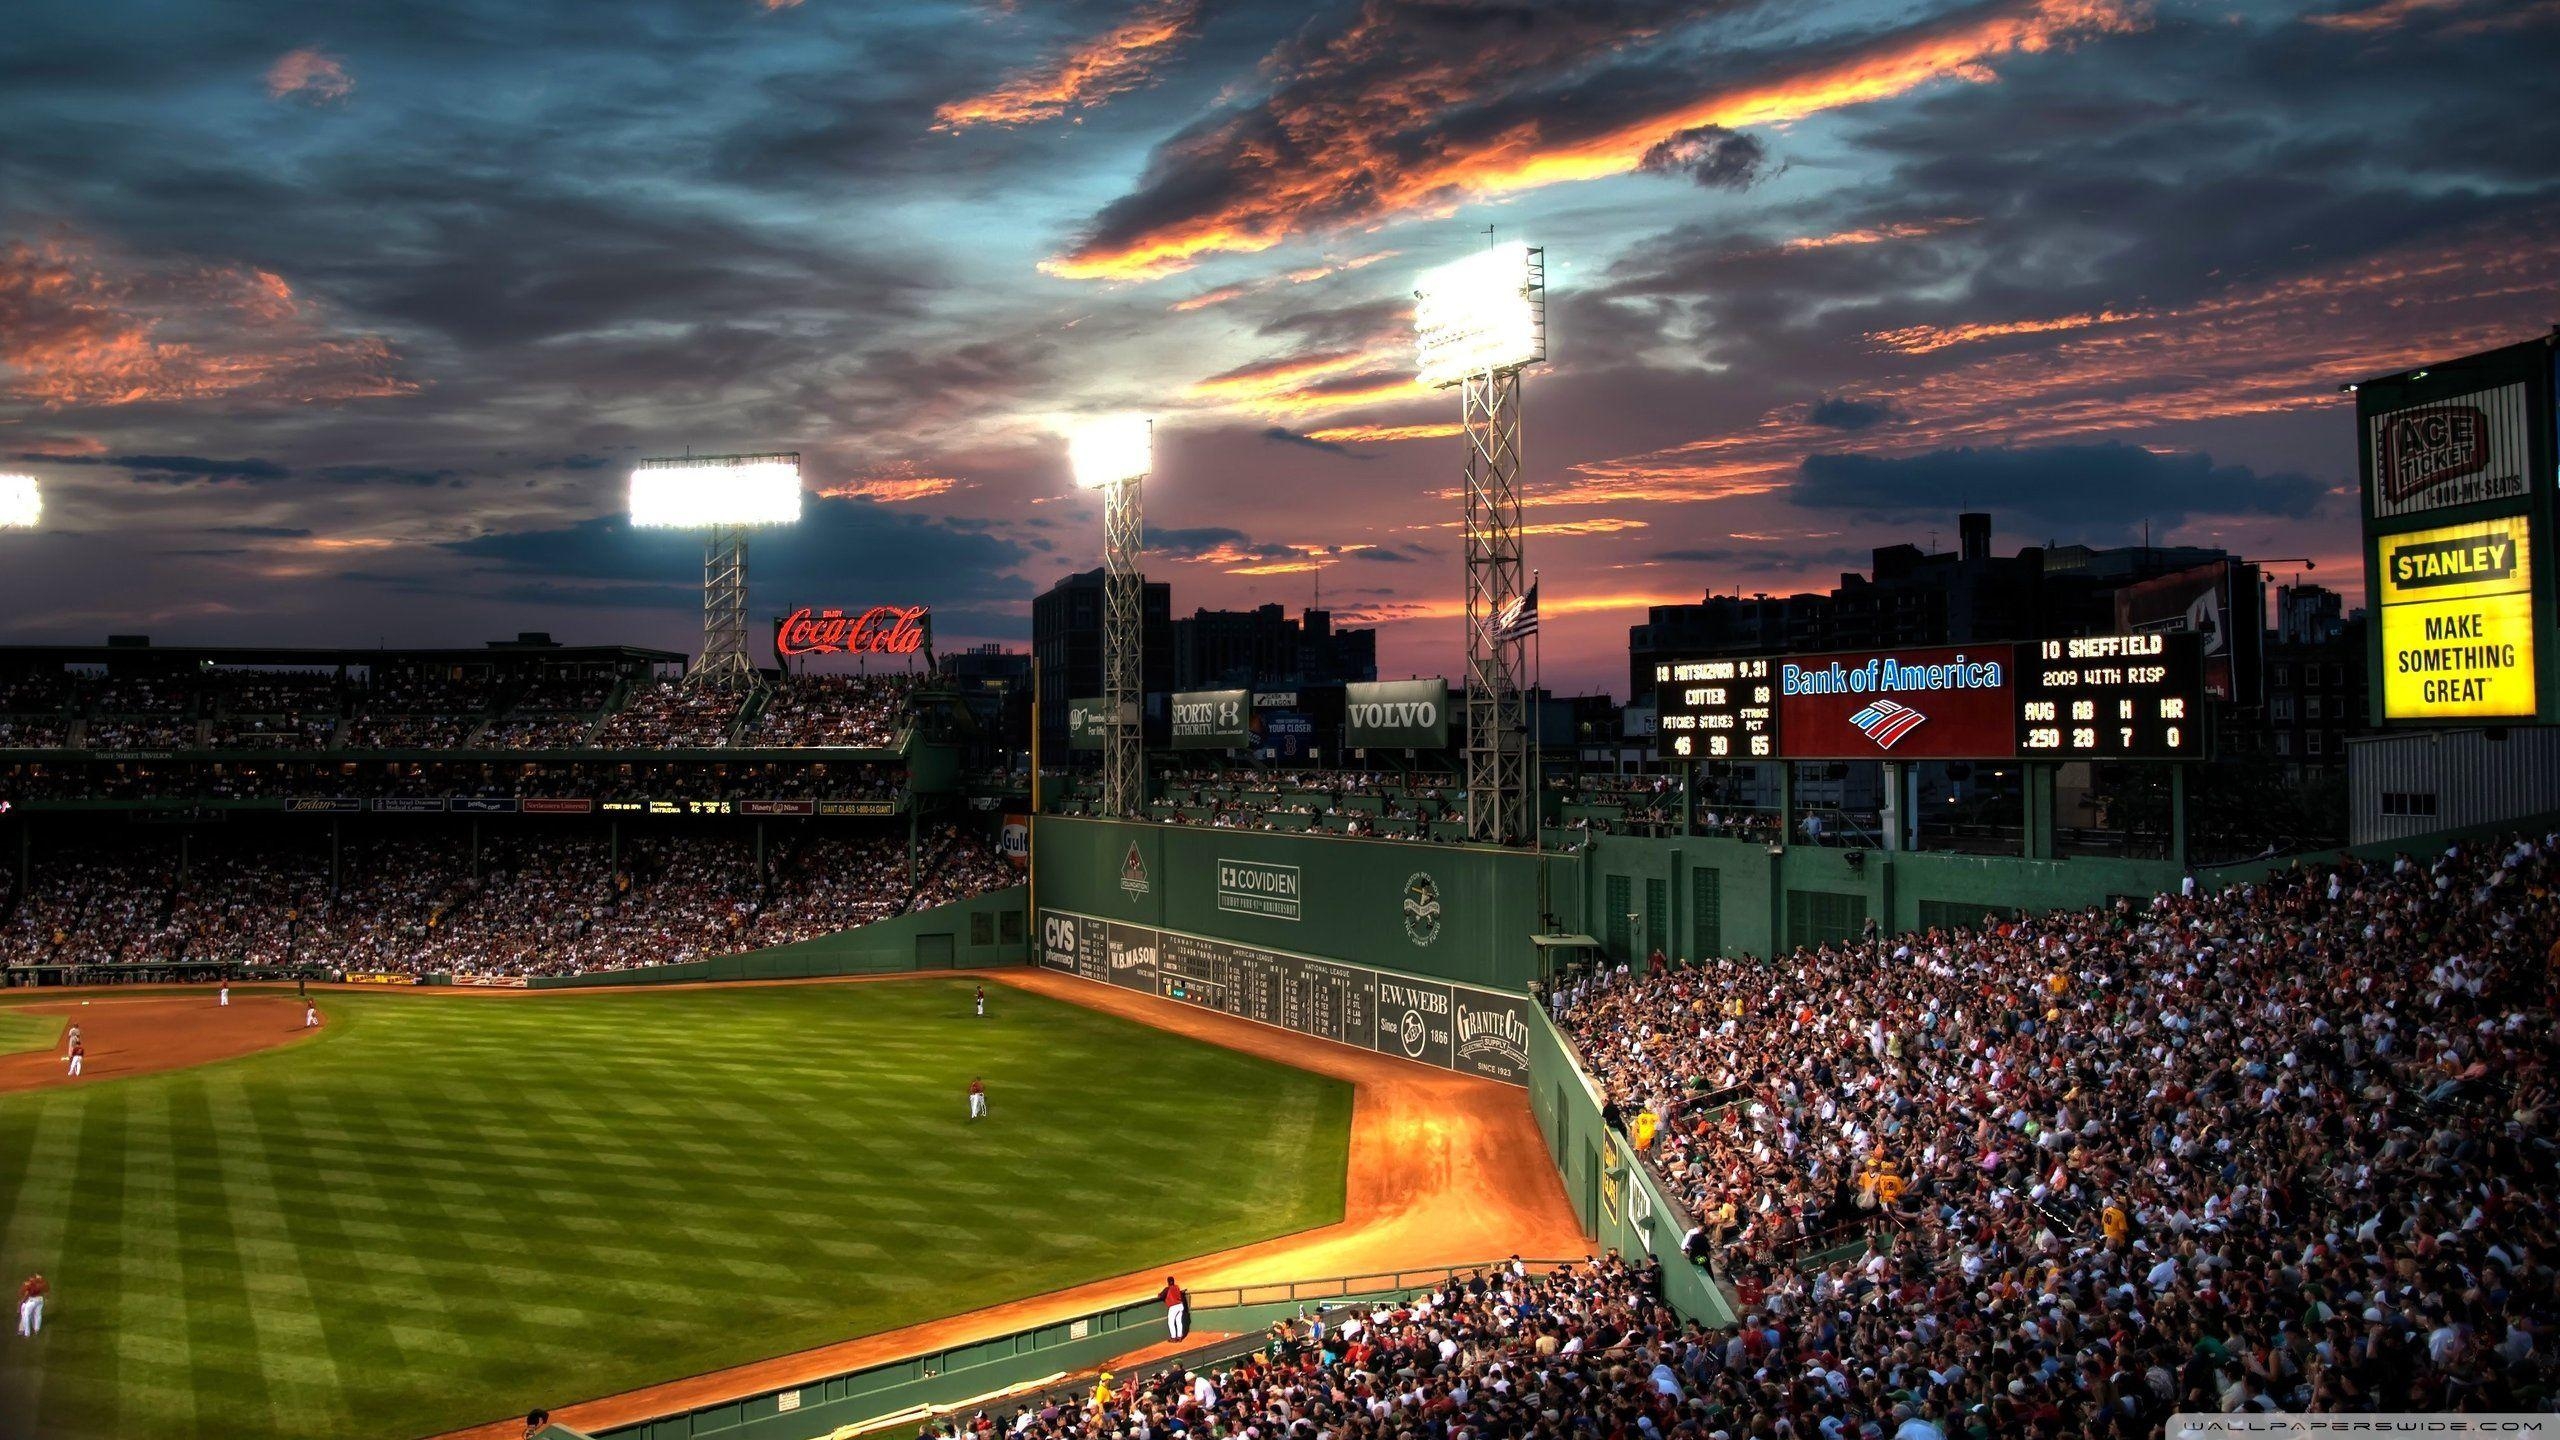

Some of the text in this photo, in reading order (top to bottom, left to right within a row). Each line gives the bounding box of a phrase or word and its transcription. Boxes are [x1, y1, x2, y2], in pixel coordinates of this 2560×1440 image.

[2400, 414, 2472, 457] ACE
[2401, 445, 2473, 486] TICKET
[2398, 544, 2506, 580] STANLEY
[2425, 613, 2483, 641] MAKE
[2042, 635, 2163, 660] 10 SHEFFIELD
[2398, 644, 2515, 673] SOMETHING
[1656, 661, 1767, 682] 18 MATSUZAKA 9.31
[1782, 654, 2001, 695] Bank of America
[2042, 667, 2166, 686] 2009 WITH RISP
[1685, 688, 1726, 705] CUTTER
[2424, 677, 2486, 703] GREAT
[1172, 702, 1213, 724] SPORTS
[1350, 701, 1437, 728] VOLVO
[1740, 708, 1769, 719] STRIKE
[2024, 698, 2184, 720] AVG AB H HR
[1172, 723, 1212, 736] AUTHORITY
[1268, 724, 1312, 732] YOUR CLOSER
[1662, 715, 1734, 729] PITCHES STRIKES
[1745, 720, 1764, 731] PCT
[1674, 735, 1769, 755] 46 30 65
[2022, 727, 2180, 748] .250 28 7 0
[293, 800, 336, 810] Jordan's
[752, 804, 772, 812] Ninety
[822, 805, 838, 813] GIANT
[839, 805, 855, 813] GLASS
[876, 806, 891, 814] GIANT
[1238, 869, 1296, 895] COVIDIEN
[1045, 917, 1075, 952] CVS
[1170, 937, 1212, 950] FENWAY PARK
[1045, 949, 1075, 969] pharmacy
[1233, 949, 1274, 962] AMERICAN LEAGUE
[1305, 963, 1350, 978] NATIONAL LEAGUE
[1406, 987, 1448, 1015] WEBB
[1380, 1018, 1398, 1034] Since
[1430, 1029, 1448, 1045] 1866
[1457, 1003, 1505, 1043] GRANITE
[1463, 1042, 1483, 1052] ELECTRIC
[1484, 1038, 1507, 1050] SUPPLY
[1477, 1062, 1512, 1077] SINCE 1923
